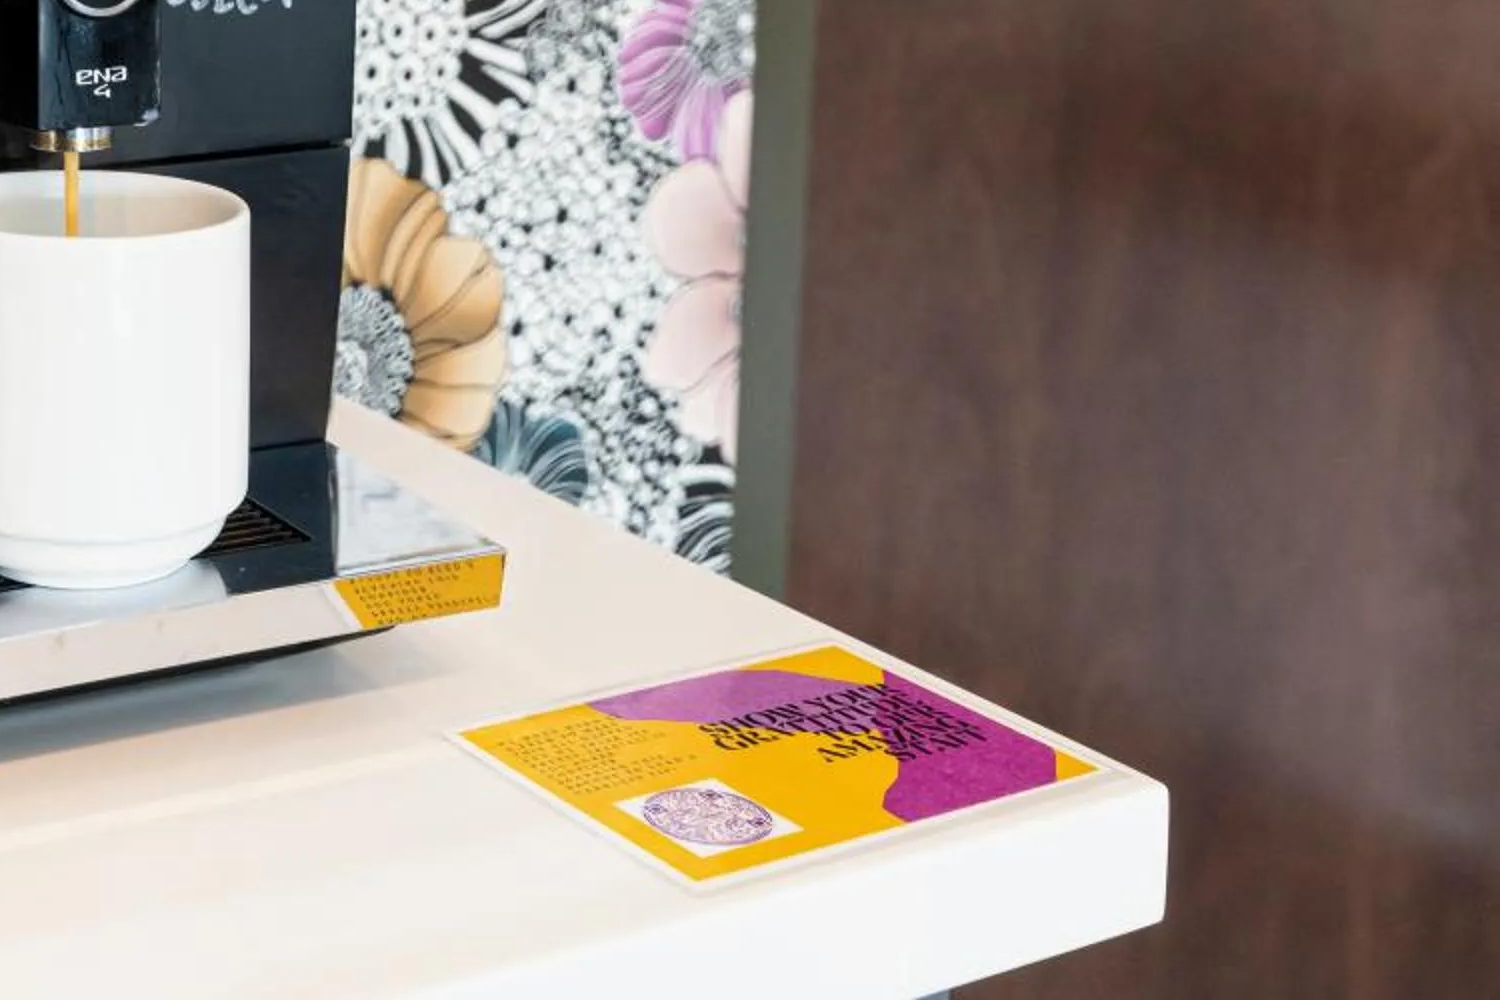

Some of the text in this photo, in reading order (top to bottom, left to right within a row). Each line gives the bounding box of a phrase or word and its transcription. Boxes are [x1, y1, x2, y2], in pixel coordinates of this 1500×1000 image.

[93, 83, 112, 98] 4
[698, 683, 900, 735] SHOW YOUR
[711, 692, 924, 751] GRATITUDE
[813, 704, 942, 742] TO OUR
[814, 715, 971, 763] AMAZING
[883, 726, 990, 761] STAFF
